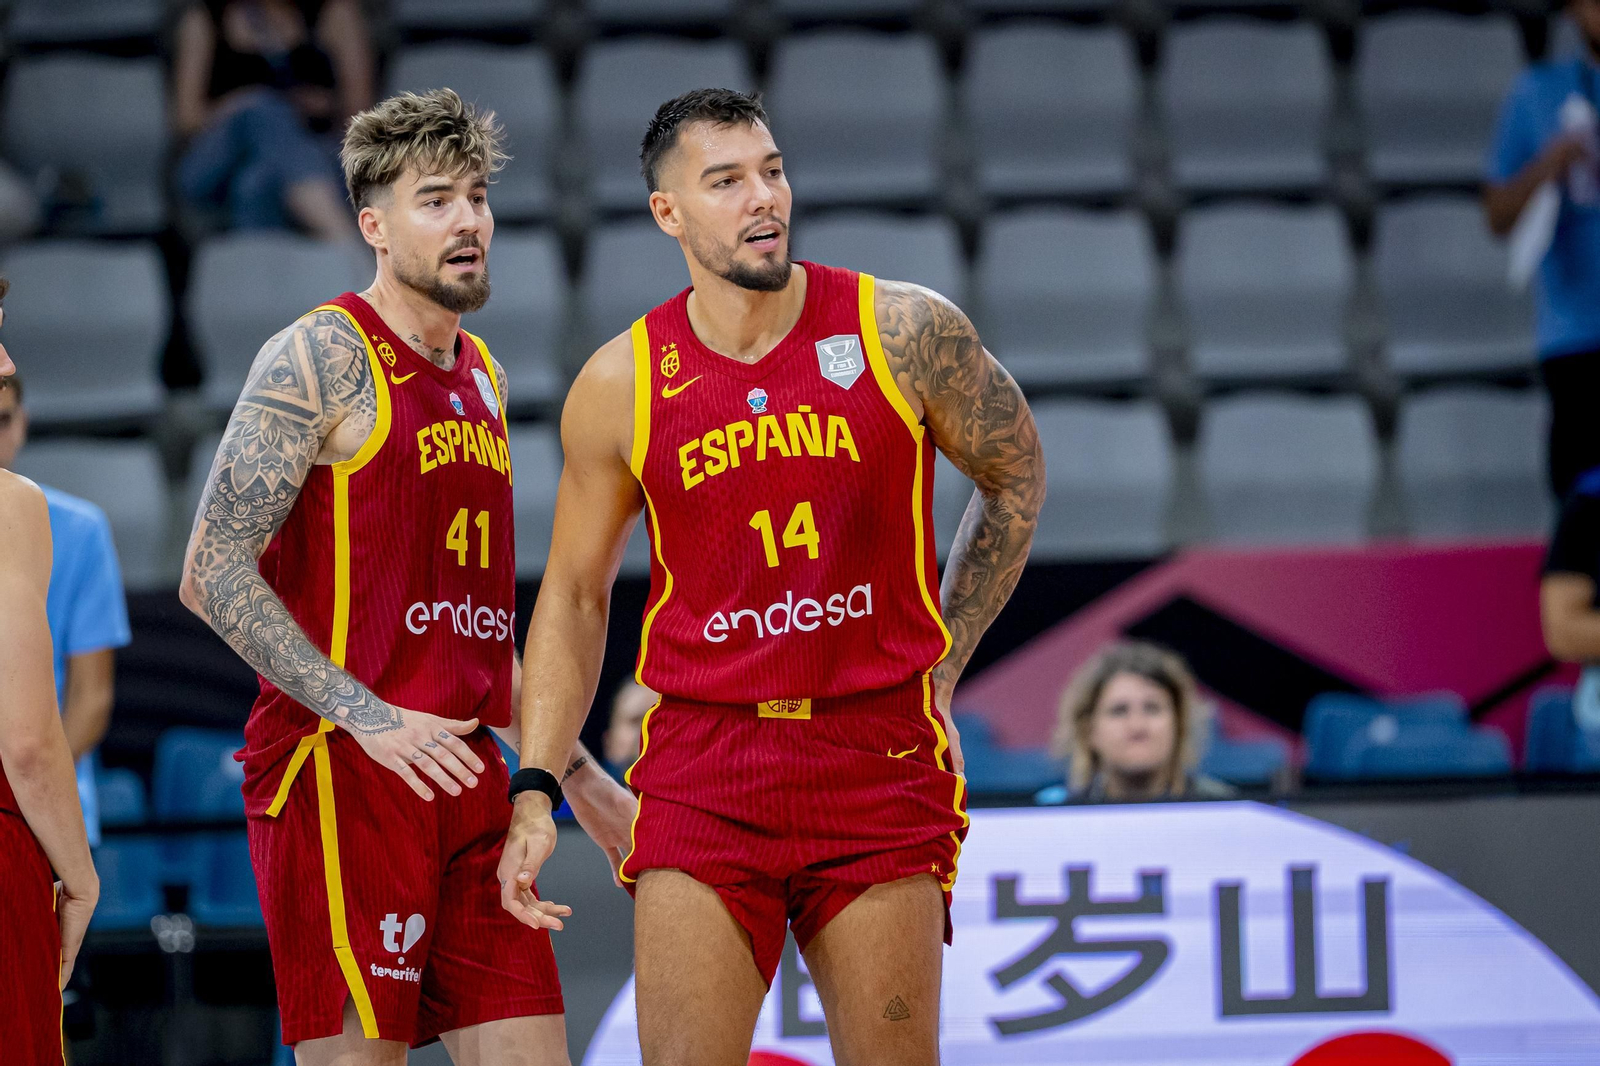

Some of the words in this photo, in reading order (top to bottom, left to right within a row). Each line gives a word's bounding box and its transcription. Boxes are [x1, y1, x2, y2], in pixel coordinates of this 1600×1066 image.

[416, 419, 513, 487] ESPAÑA
[678, 405, 861, 491] ESPAÑA
[446, 508, 490, 569] 41
[749, 501, 820, 568] 14
[703, 583, 873, 643] endesa
[779, 864, 1391, 1038] 岁山
